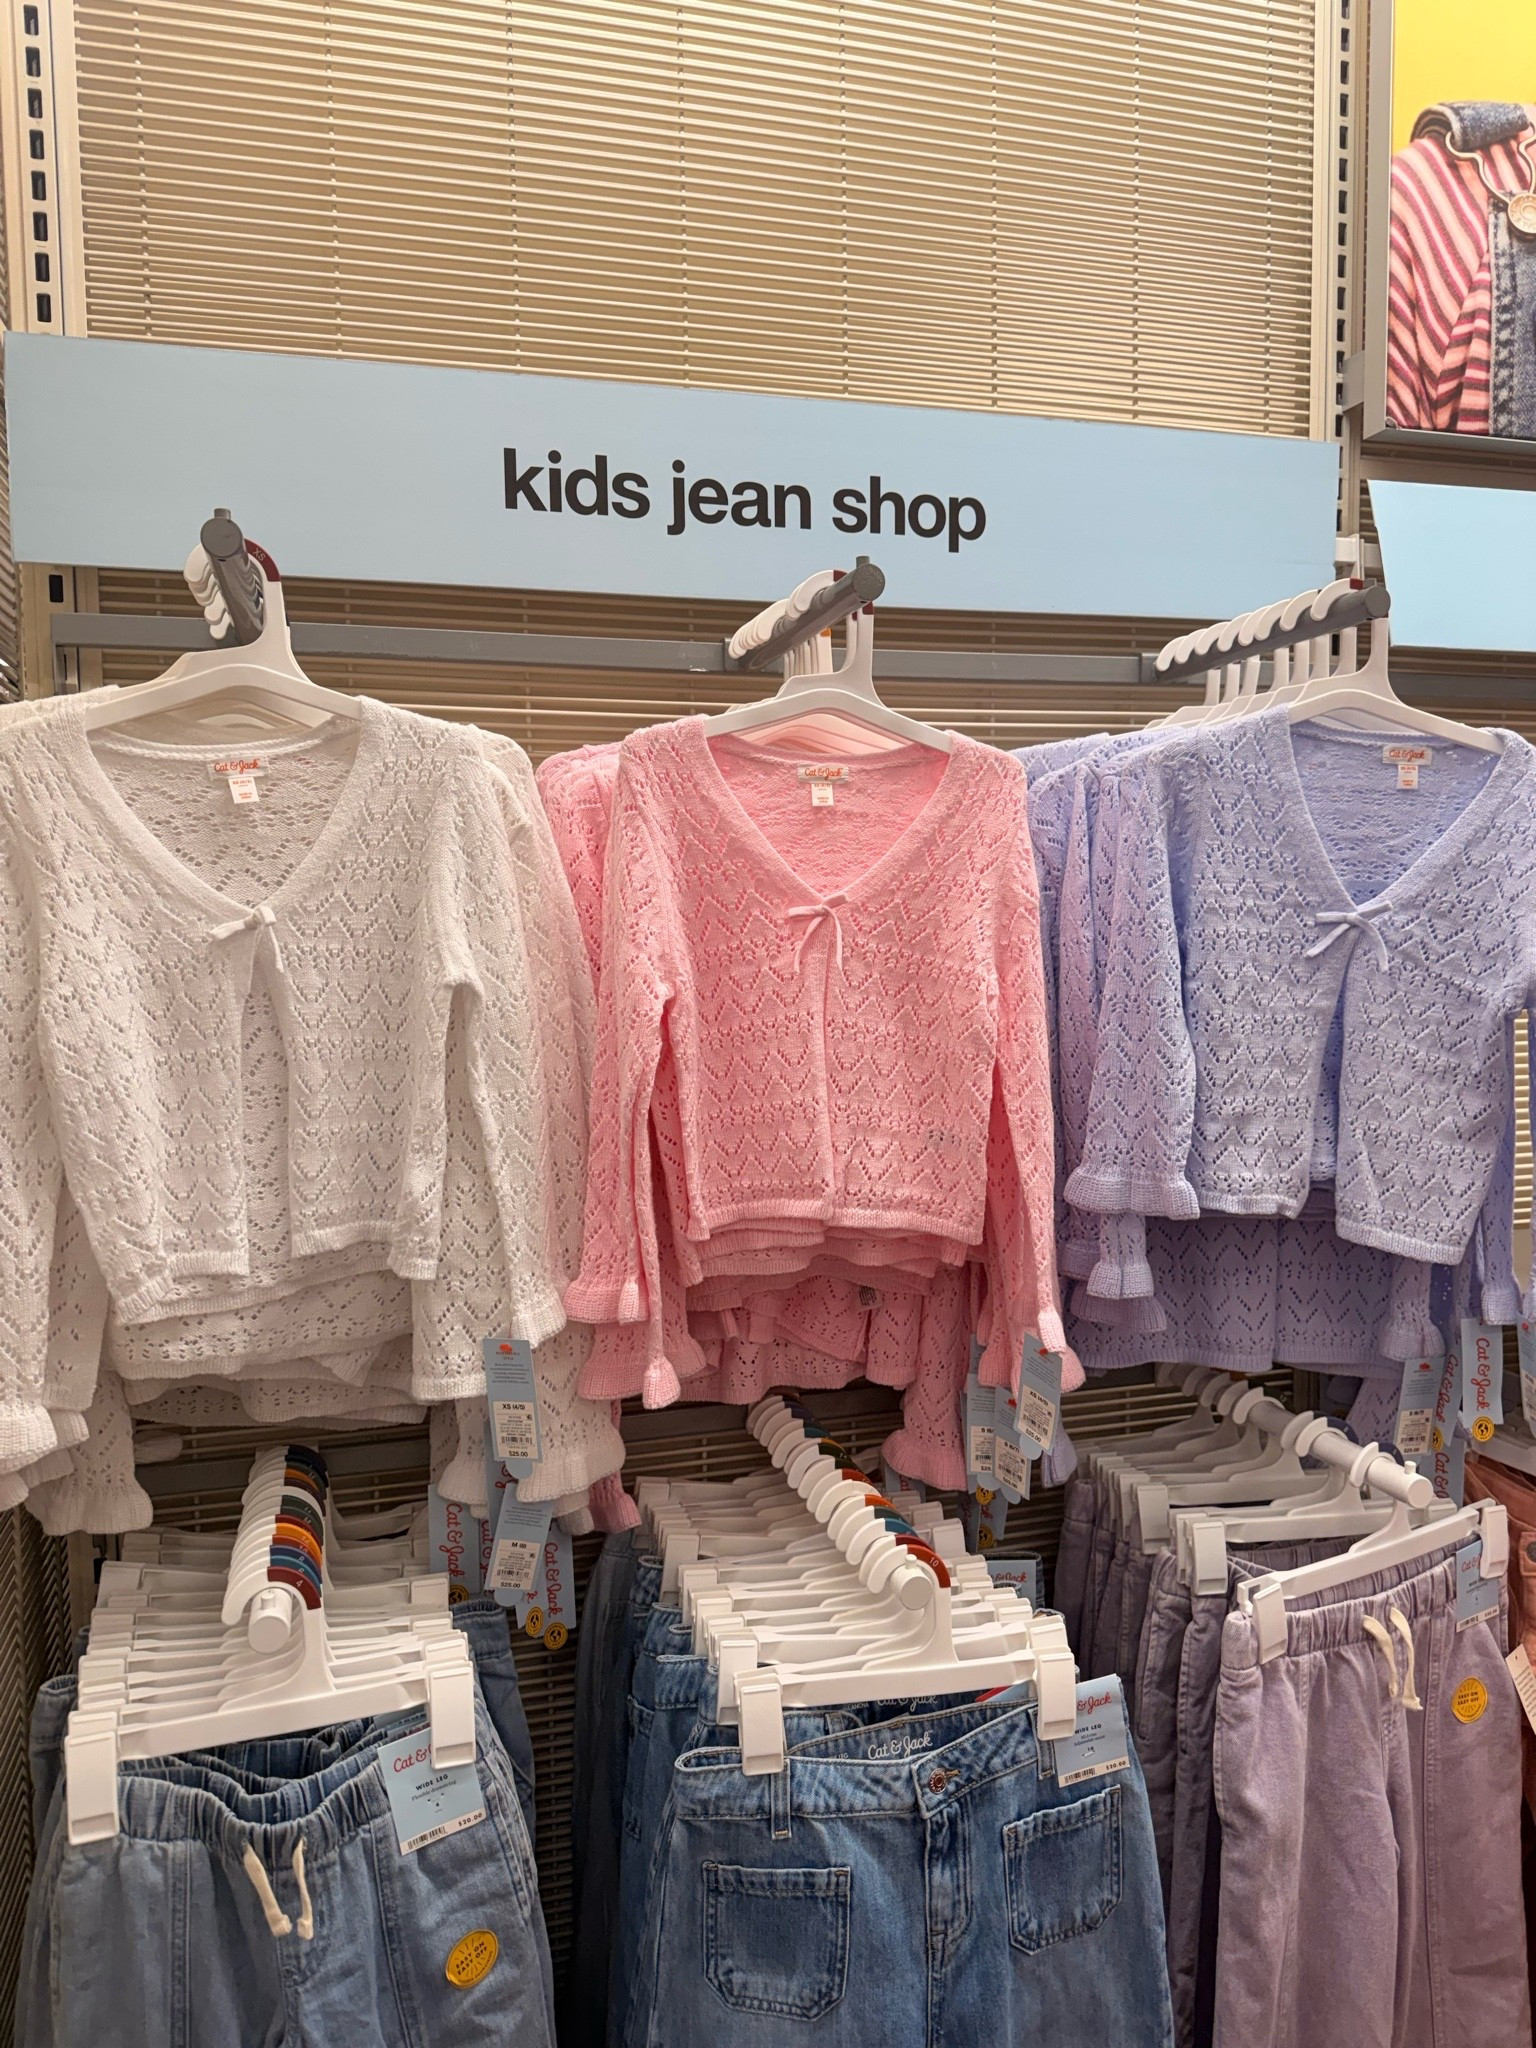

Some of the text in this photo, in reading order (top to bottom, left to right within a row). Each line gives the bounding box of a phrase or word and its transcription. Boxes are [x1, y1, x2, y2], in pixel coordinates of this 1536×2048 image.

[503, 447, 987, 554] kids jean shop
[252, 547, 267, 562] XS
[1389, 749, 1426, 763] Cat & Jack
[213, 758, 261, 775] Cat & Jack
[804, 767, 844, 781] Cat & Jack
[1475, 1337, 1490, 1362] Cat
[1477, 1363, 1491, 1378] &
[1435, 1354, 1458, 1424] Cat & Jack
[1470, 1377, 1491, 1411] Jack
[512, 1403, 526, 1411] (4/5)
[1025, 1428, 1042, 1443] $25.00
[508, 1450, 529, 1458] $25.00
[1434, 1452, 1450, 1491] Cat &
[439, 1503, 465, 1578] Cat & Jack
[544, 1542, 559, 1567] Cat
[930, 1556, 940, 1567] 10
[546, 1567, 560, 1582] &
[295, 1579, 304, 1588] 4
[500, 1581, 521, 1589] $25.00
[546, 1583, 563, 1618] Jack
[1076, 1691, 1113, 1715] & Jack
[1074, 1723, 1103, 1735] WIDE LEG
[867, 1730, 934, 1760] Cat & Jack
[393, 1748, 428, 1773] Cat &
[1105, 1760, 1127, 1771] $20.00
[415, 1773, 449, 1791] WIDE LEG
[458, 1812, 483, 1827] $20.00
[455, 1941, 485, 1969] EASY ON
[457, 1945, 488, 1976] EASY OFF
